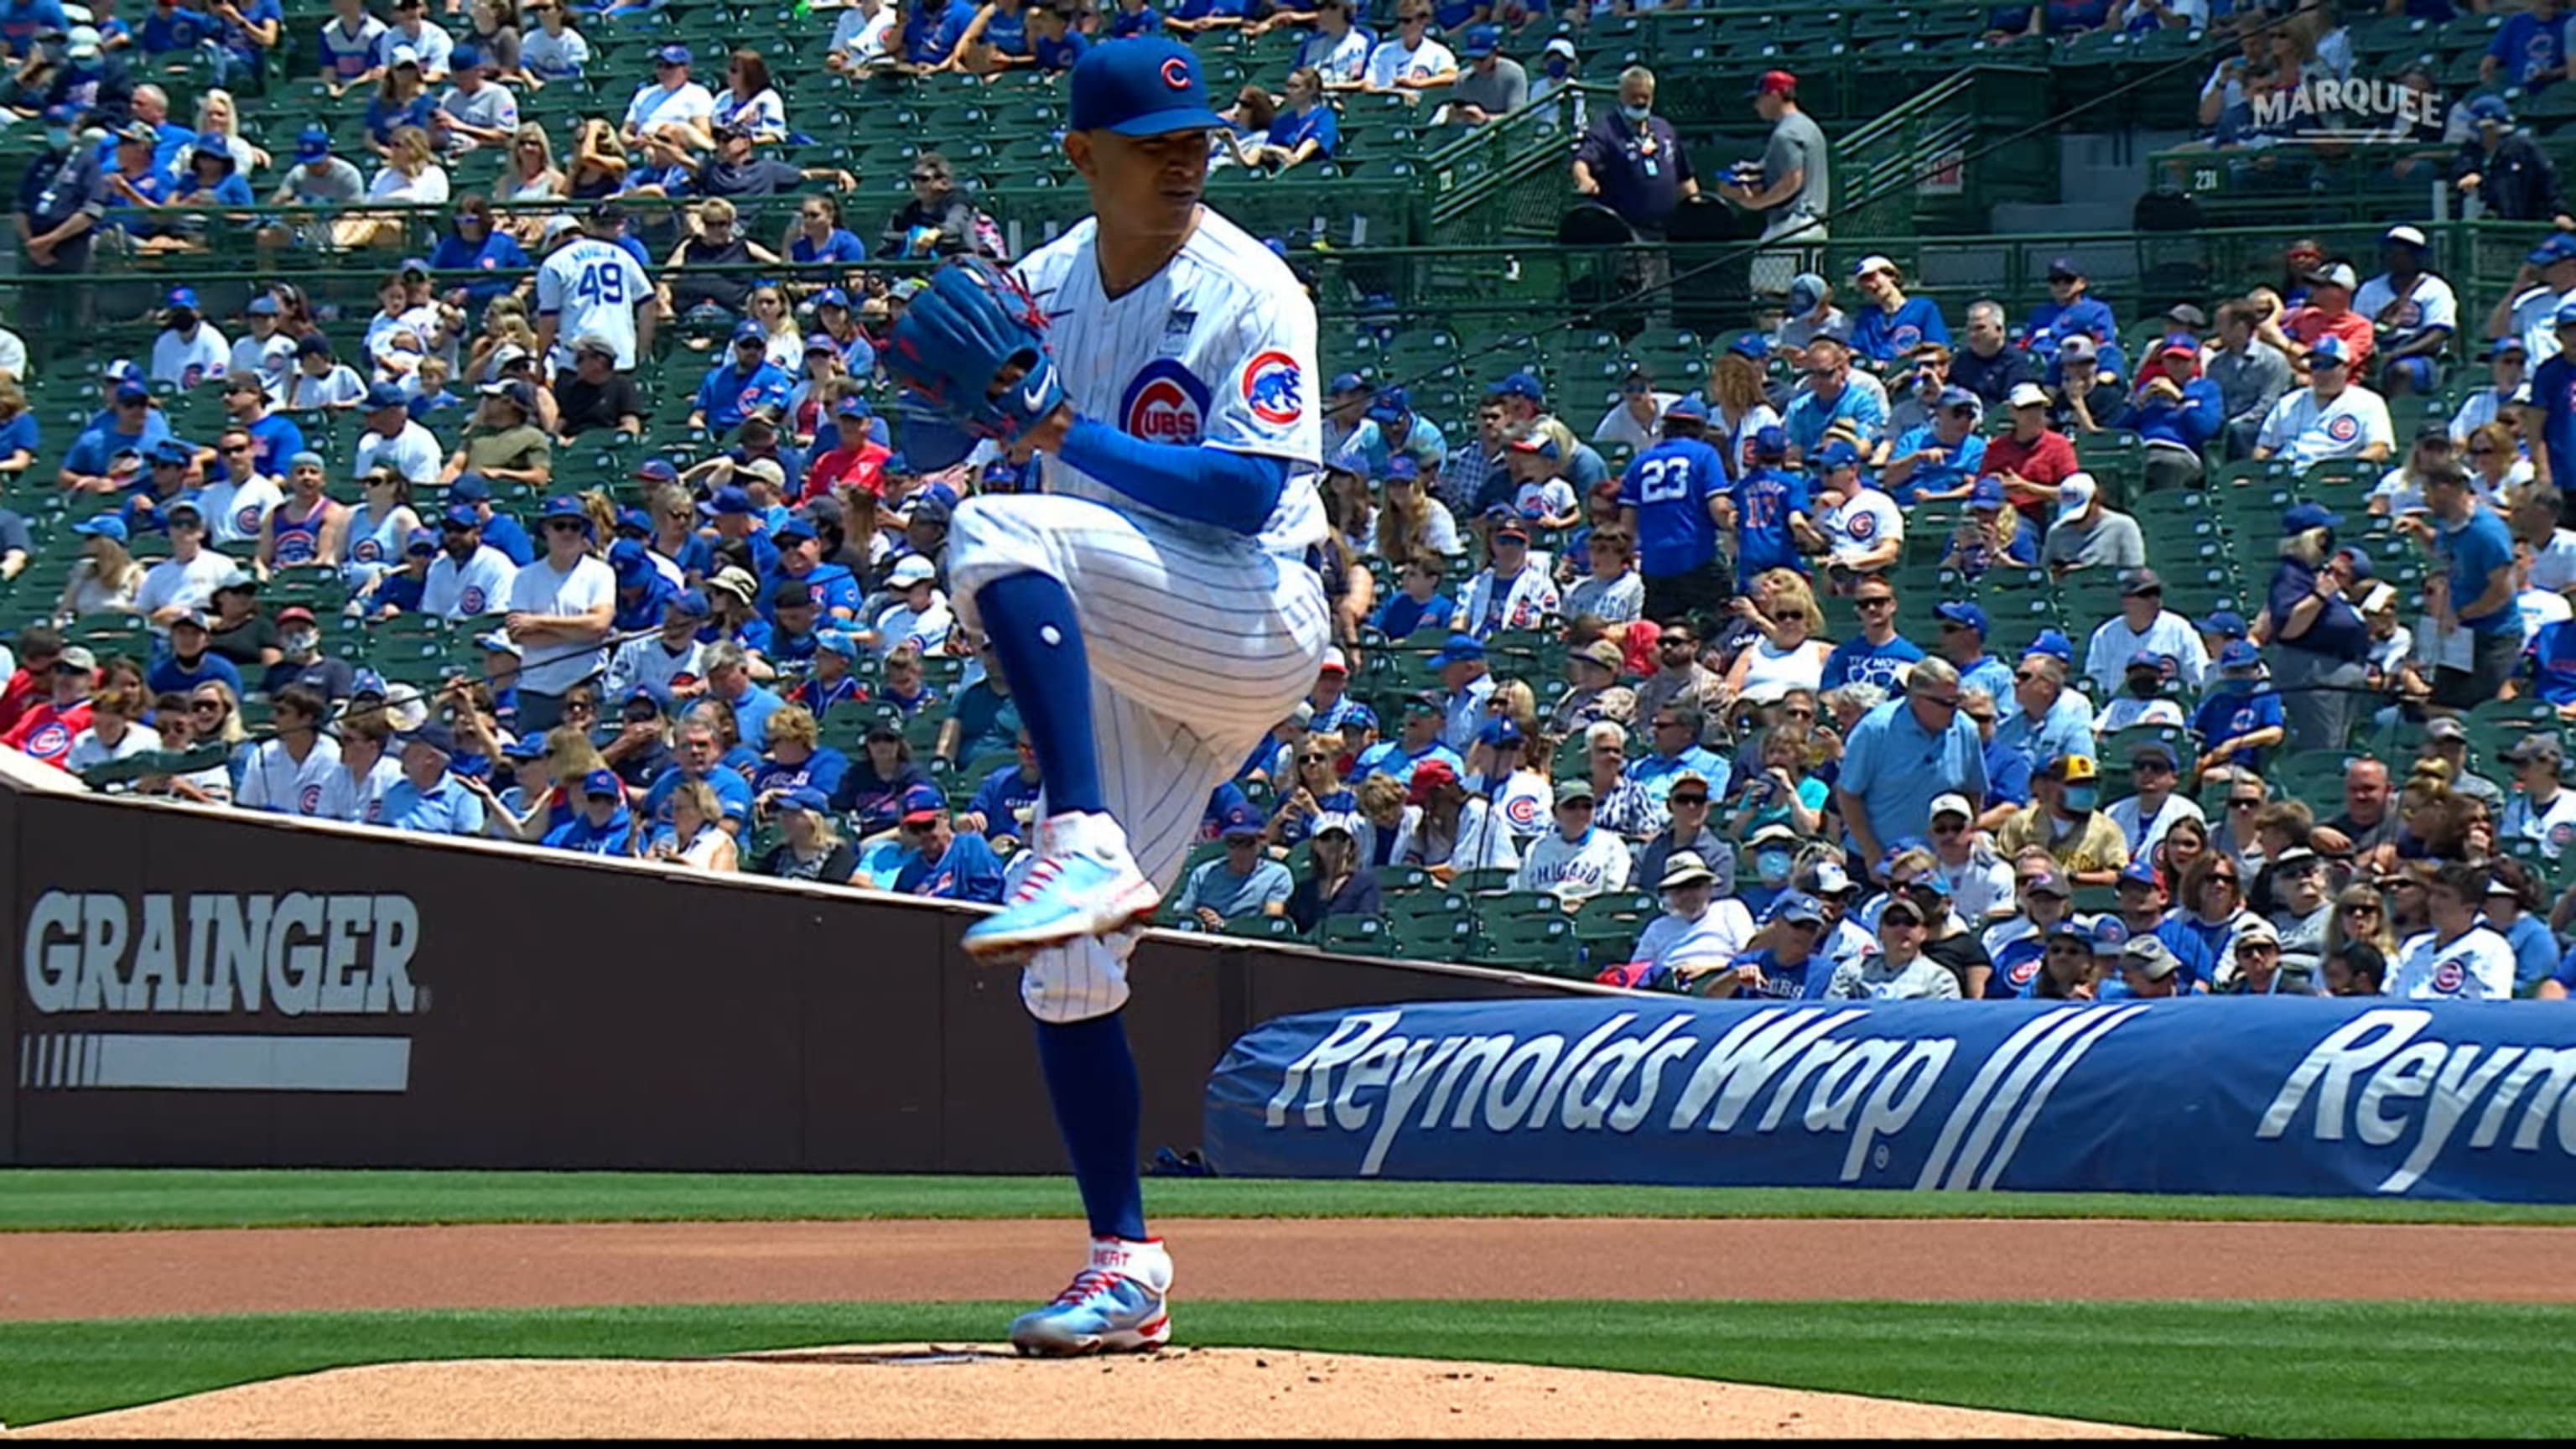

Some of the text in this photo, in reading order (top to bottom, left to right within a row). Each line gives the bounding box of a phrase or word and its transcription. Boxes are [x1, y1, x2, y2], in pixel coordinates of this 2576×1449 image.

[2195, 169, 2217, 190] 231
[579, 262, 623, 306] 49
[1641, 456, 1690, 503] 23
[24, 891, 420, 1016] GRAINGER
[1265, 1008, 1957, 1182] Reynolds Wrap
[2255, 1009, 2576, 1193] Reyn
